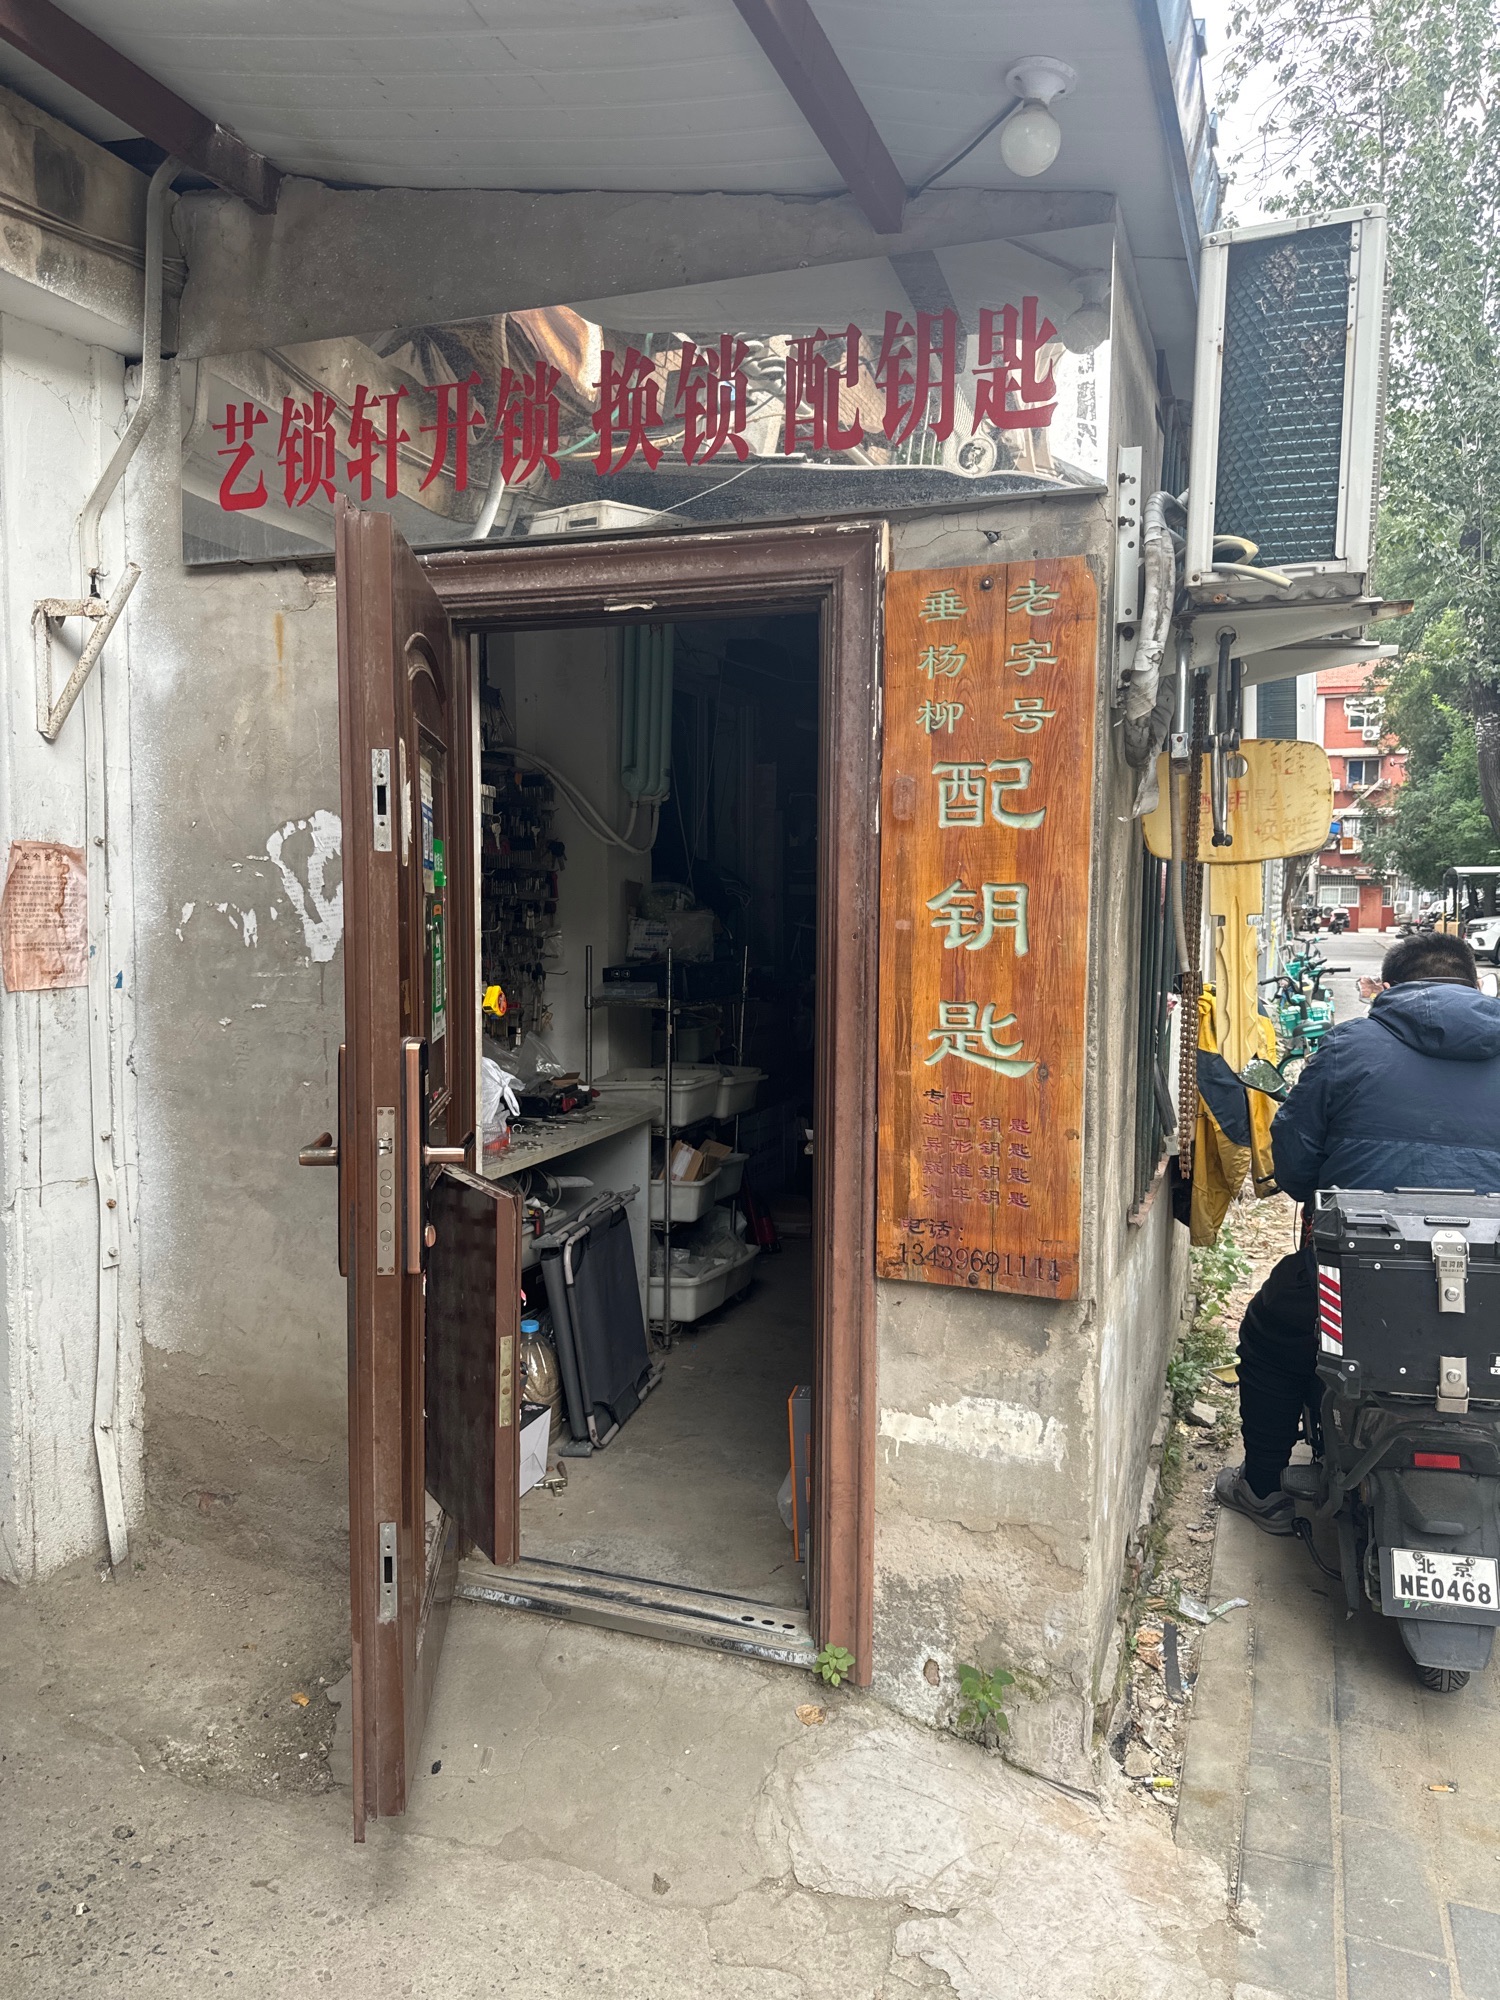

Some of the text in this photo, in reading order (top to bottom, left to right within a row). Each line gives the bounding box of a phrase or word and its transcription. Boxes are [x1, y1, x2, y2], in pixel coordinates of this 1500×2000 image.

[915, 587, 969, 734] 垂杨柳
[1002, 578, 1061, 734] 老字号
[924, 757, 1047, 1078] 配钥匙
[922, 1088, 975, 1107] 专配
[922, 1113, 1032, 1136] 进口钥匙
[922, 1137, 1032, 1160] 异形钥匙
[922, 1160, 1031, 1185] 疑难钥匙
[922, 1184, 1031, 1209] 汽车钥匙
[898, 1242, 1060, 1283] 13439691111
[1417, 1558, 1473, 1578] 北京
[1400, 1574, 1492, 1605] NE0468
